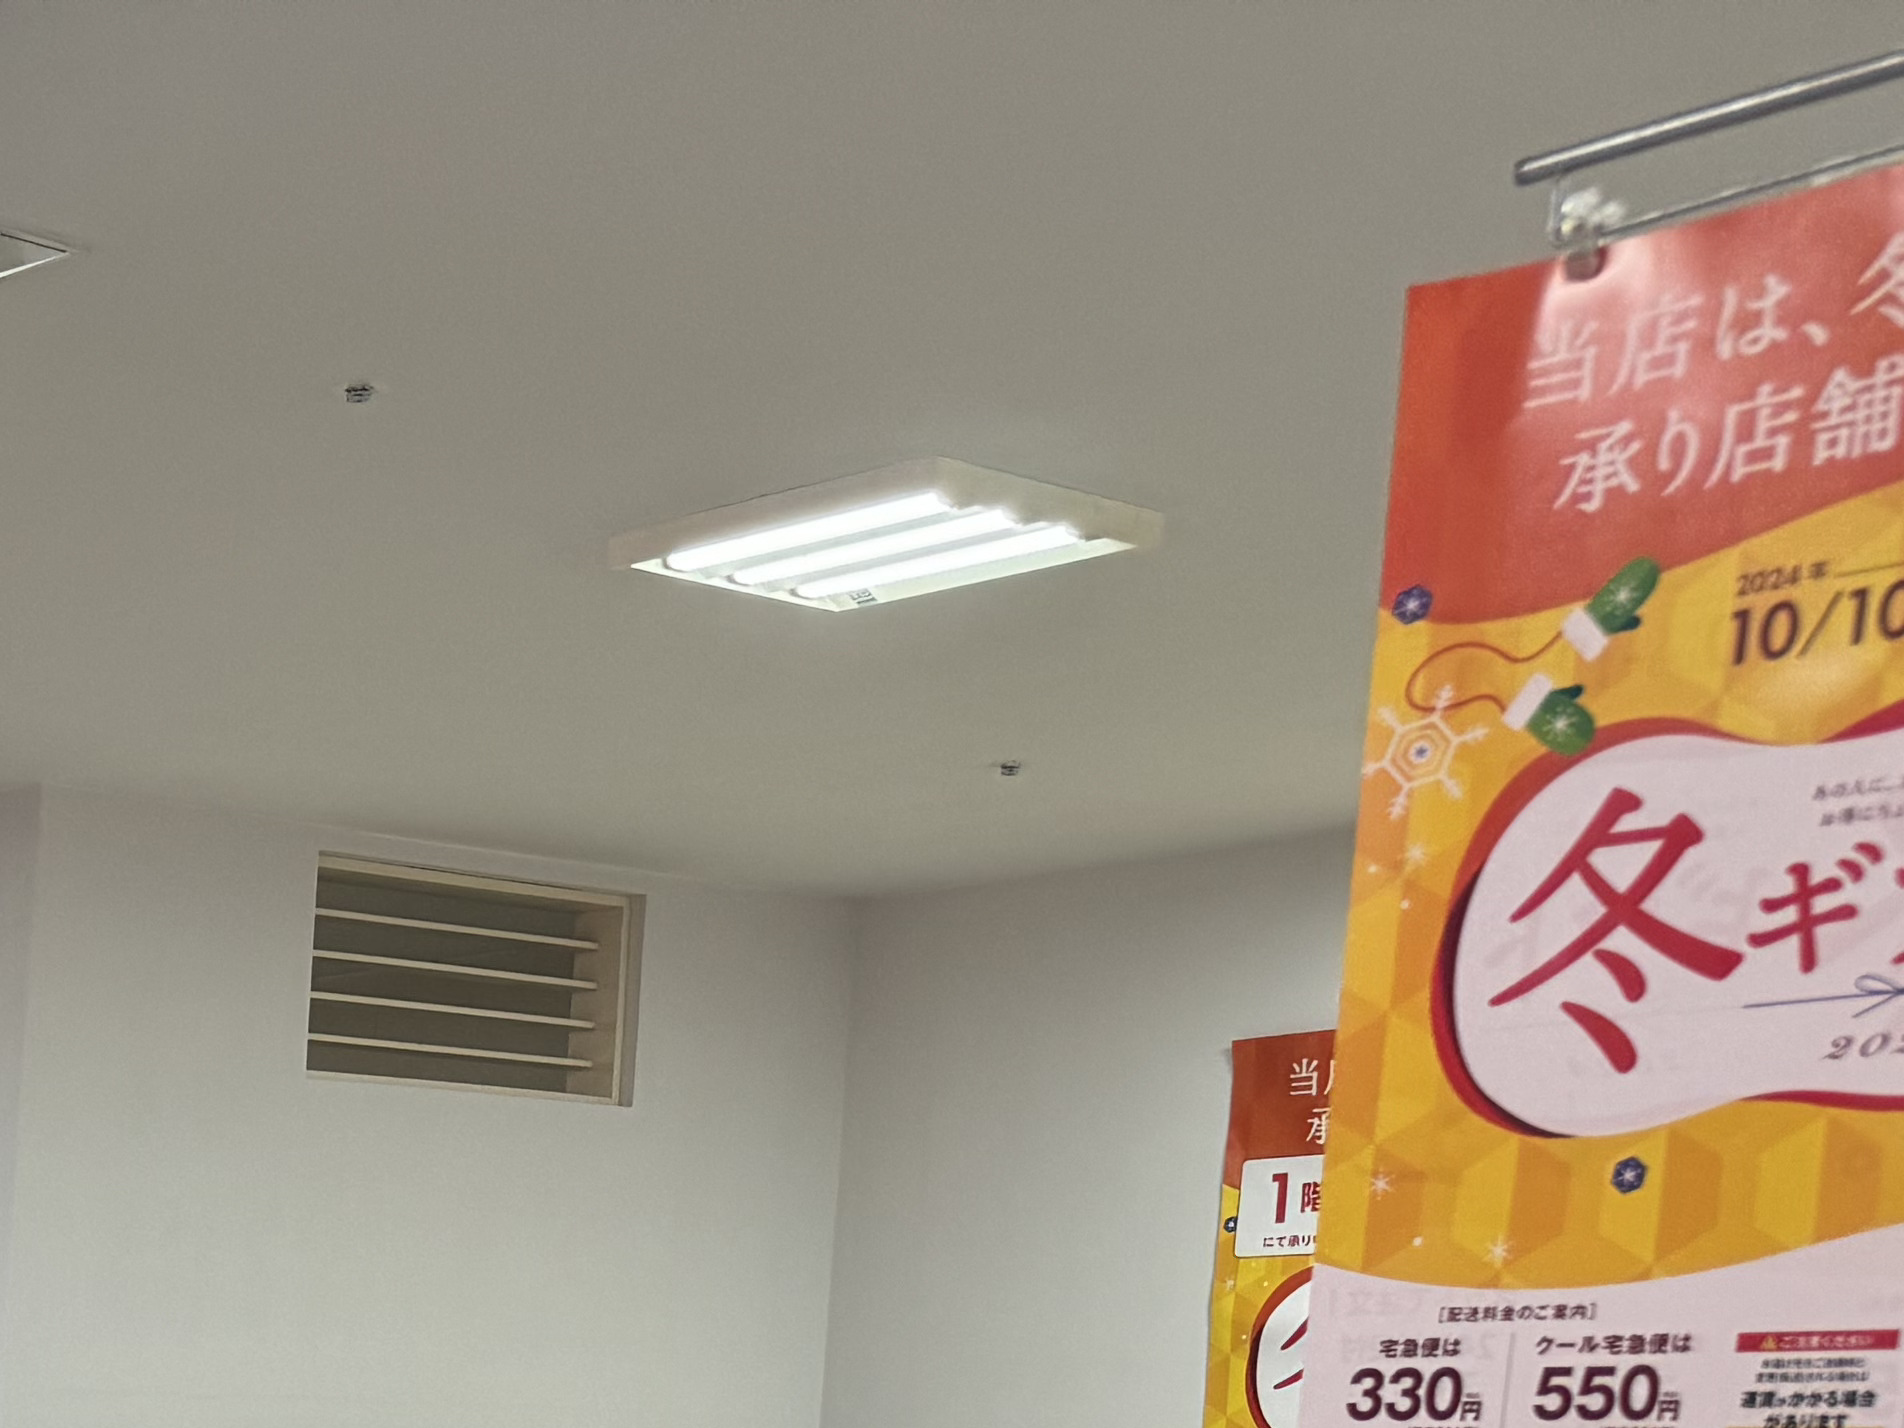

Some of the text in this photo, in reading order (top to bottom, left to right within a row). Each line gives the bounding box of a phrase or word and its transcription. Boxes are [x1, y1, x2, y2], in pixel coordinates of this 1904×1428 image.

[1488, 788, 1904, 1074] 冬ギ
[1379, 1337, 1462, 1358] 宅急便は
[1535, 1332, 1693, 1355] クール宅急便は
